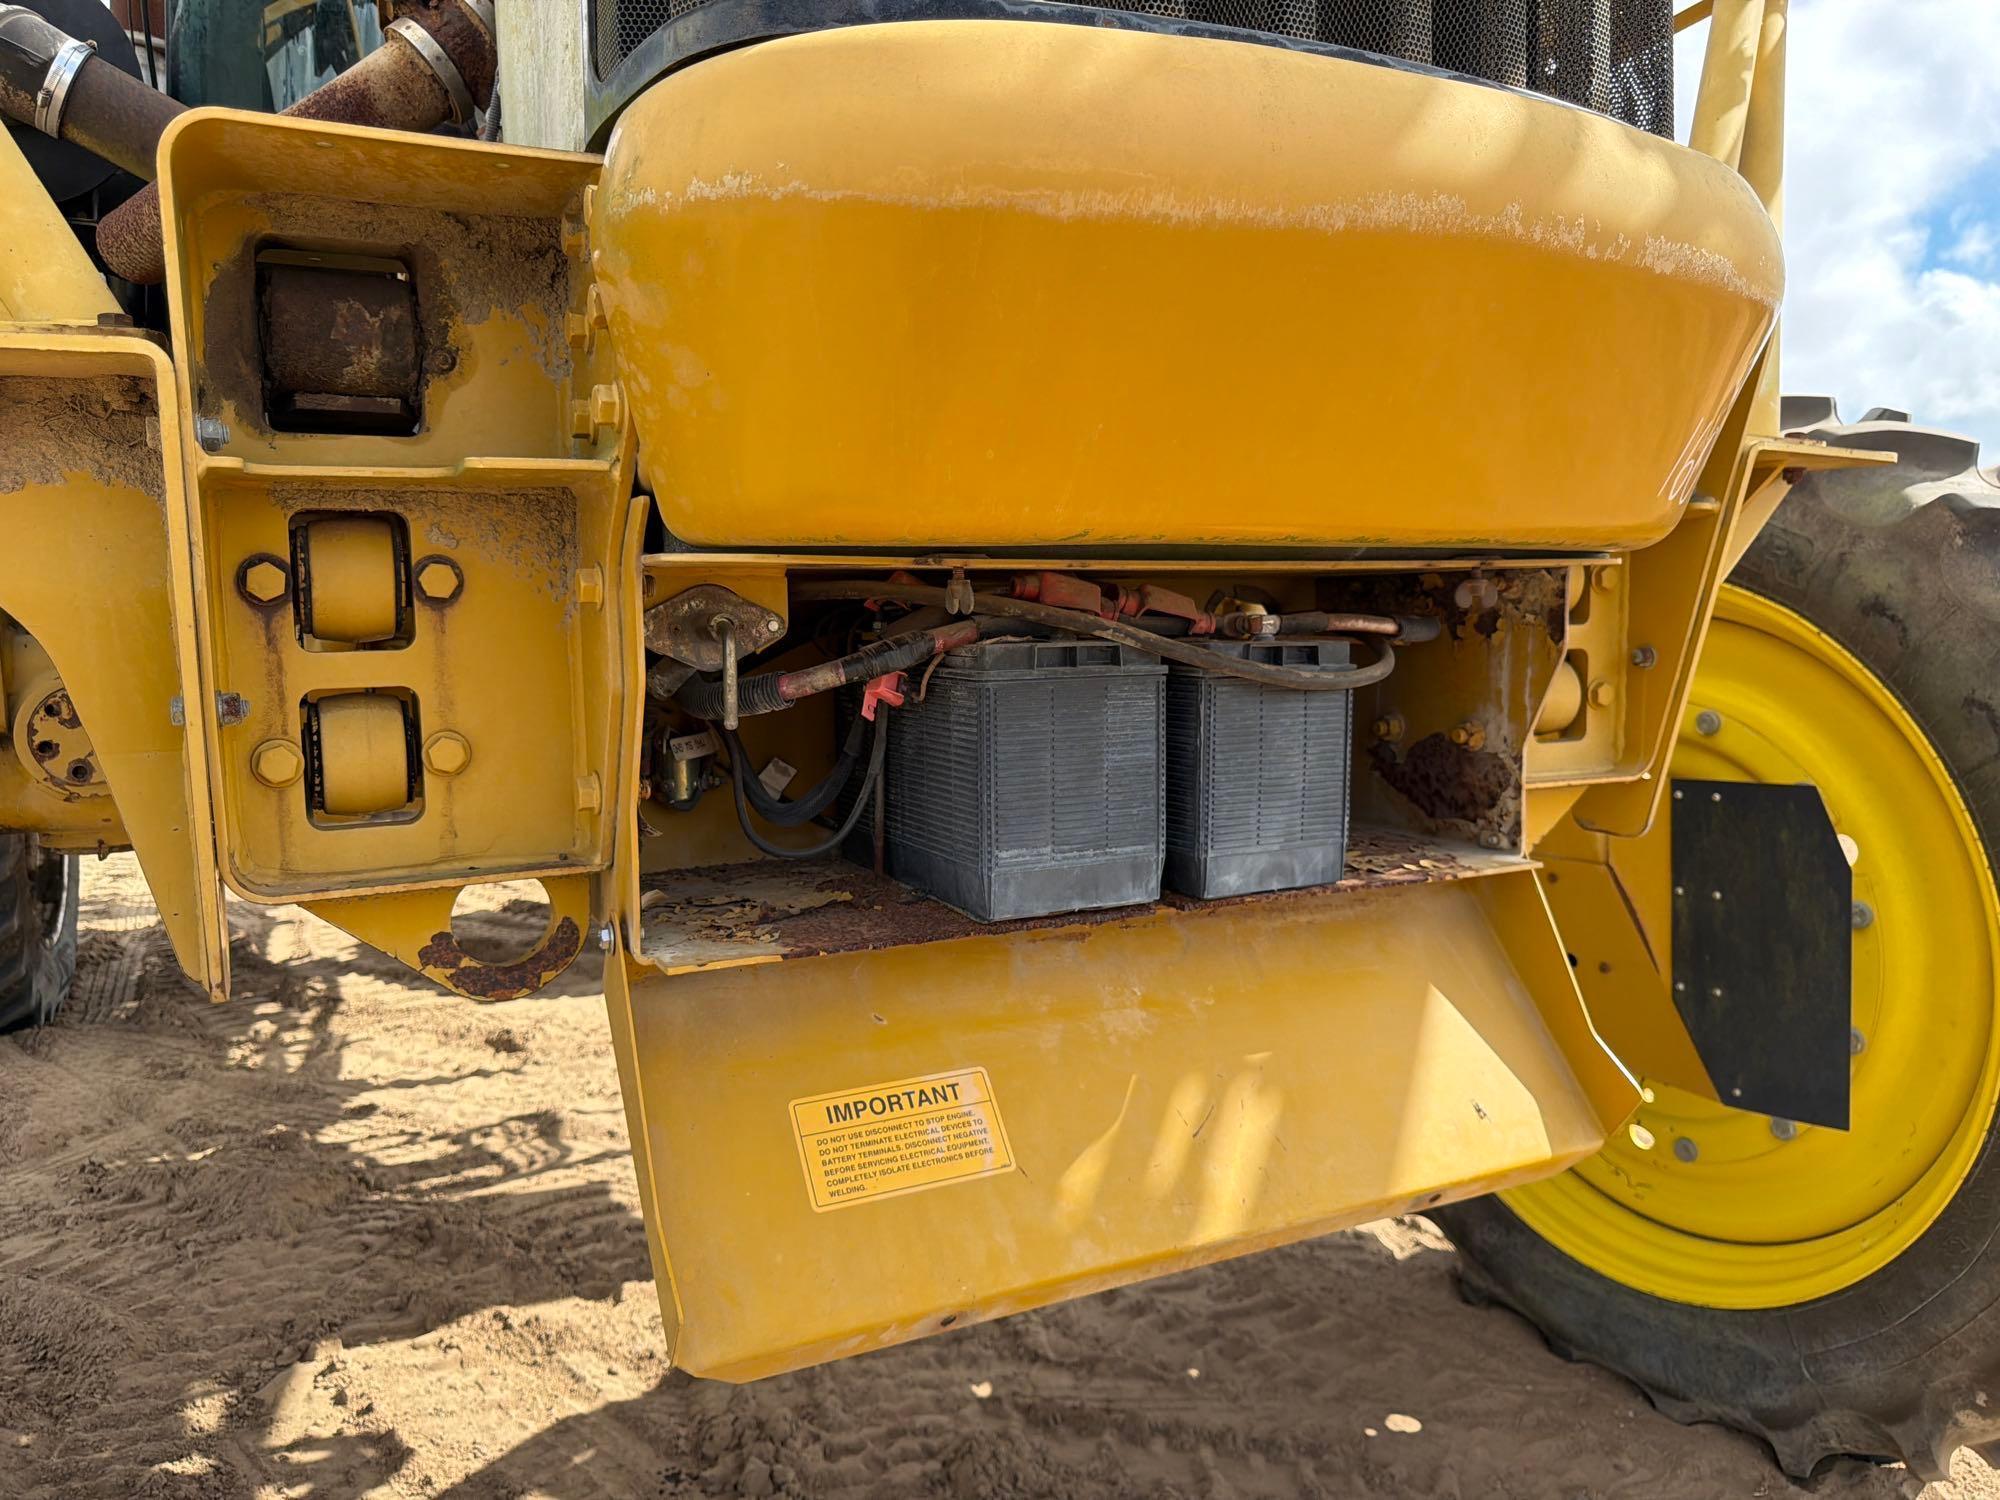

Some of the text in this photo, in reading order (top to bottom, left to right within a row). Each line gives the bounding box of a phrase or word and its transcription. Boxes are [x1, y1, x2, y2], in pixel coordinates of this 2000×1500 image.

[826, 1083, 959, 1124] IMPORTANT
[817, 1138, 828, 1146] DO
[830, 1135, 846, 1144] NOT
[848, 1130, 863, 1140] USE
[865, 1121, 912, 1136] DISCONNECT
[926, 1116, 945, 1125] STOP
[822, 1154, 856, 1166] BATTERY
[905, 1135, 951, 1149] DISCONNECT
[953, 1128, 988, 1140] NEGATIVE
[833, 1145, 848, 1153] NOT
[851, 1135, 893, 1149] TERMINATE
[894, 1128, 940, 1141] ELECTRICAL
[941, 1120, 972, 1132] DEVICES
[974, 1118, 983, 1126] TO
[825, 1164, 856, 1177] BEFORE
[858, 1156, 899, 1170] SERVICING
[900, 1147, 945, 1161] ELECTRICAL
[826, 1147, 993, 1187] COMPLETELY ISOLATE ELECTRONICS BEFORE
[829, 1184, 868, 1198] WELDING.
